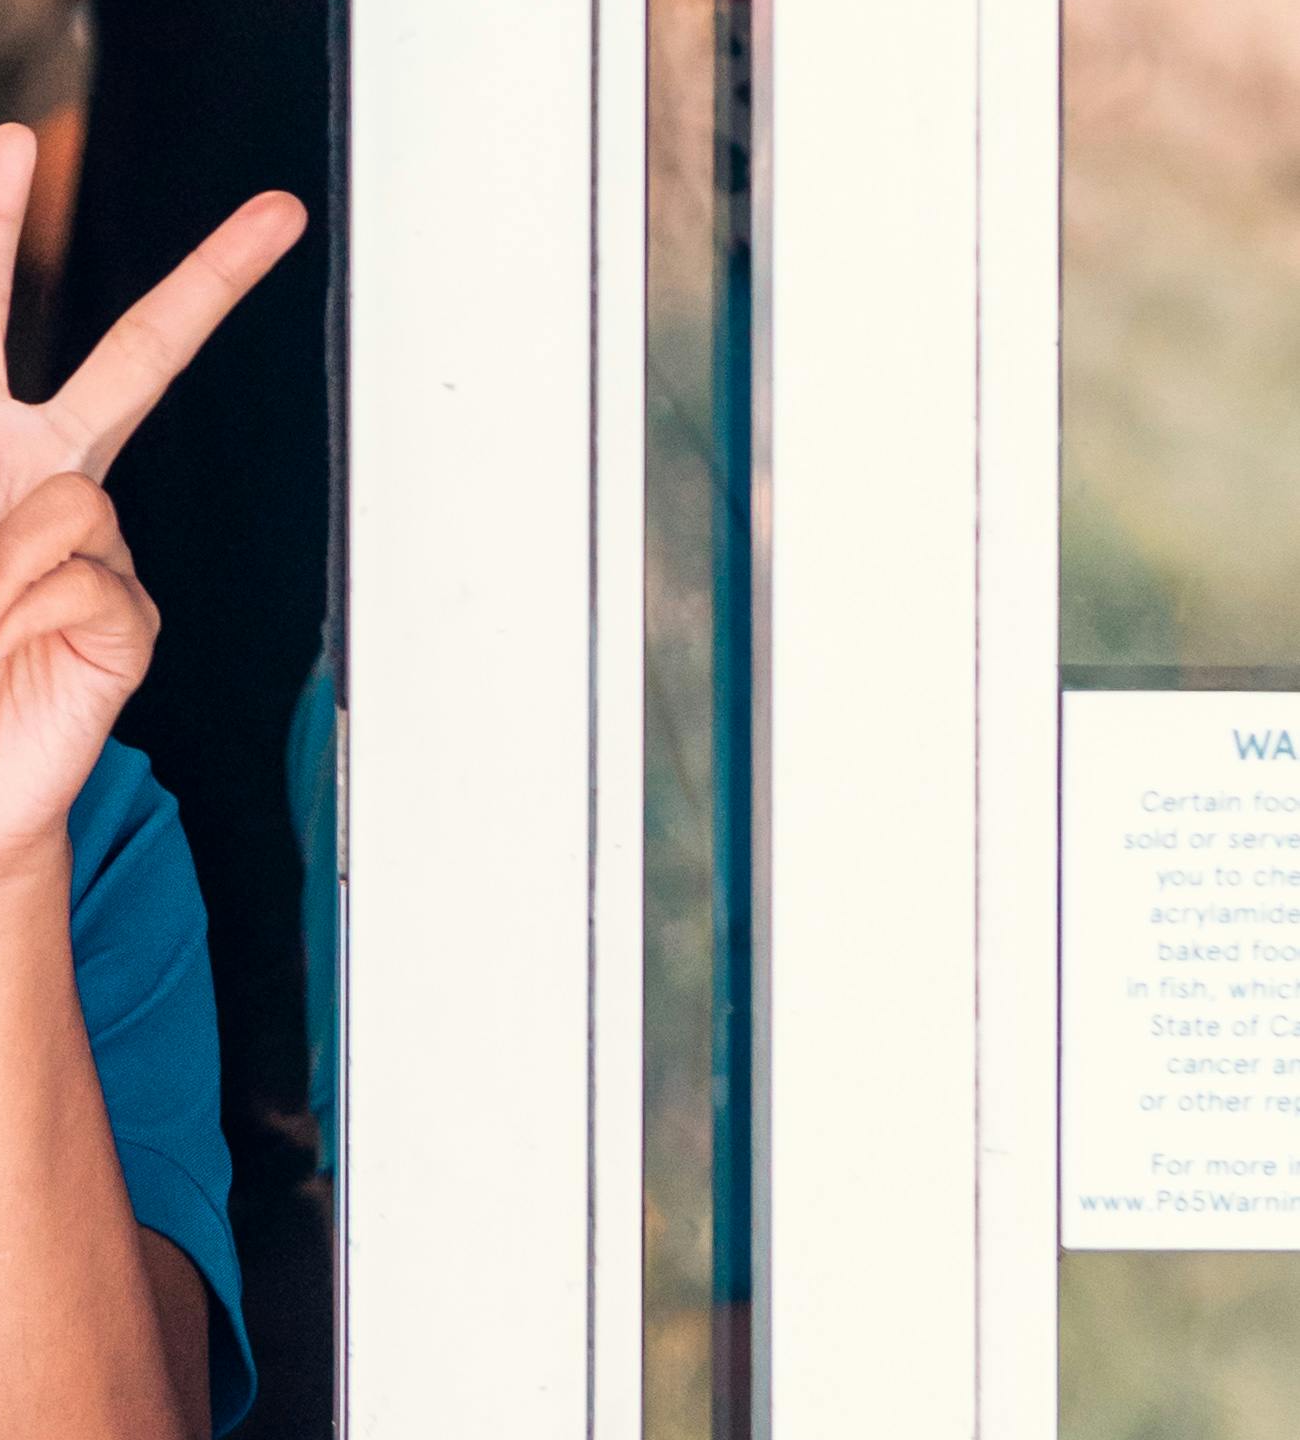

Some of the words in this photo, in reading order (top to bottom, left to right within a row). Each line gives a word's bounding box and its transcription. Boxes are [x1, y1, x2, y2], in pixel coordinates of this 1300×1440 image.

[1141, 790, 1241, 813] Certain
[1253, 790, 1300, 813] foo
[1123, 828, 1178, 850] sold
[1189, 832, 1216, 850] or
[1156, 869, 1204, 891] you
[1215, 866, 1242, 887] to
[1157, 939, 1240, 963] baked
[1252, 939, 1300, 963] foo
[1127, 976, 1149, 1000] in
[1159, 975, 1216, 1004] fish,
[1150, 1013, 1222, 1038] State
[1232, 1013, 1260, 1038] of
[1166, 1056, 1261, 1076] cancer
[1139, 1094, 1167, 1113] or
[1177, 1089, 1254, 1113] other
[1151, 1152, 1194, 1177] For
[1206, 1159, 1278, 1177] more
